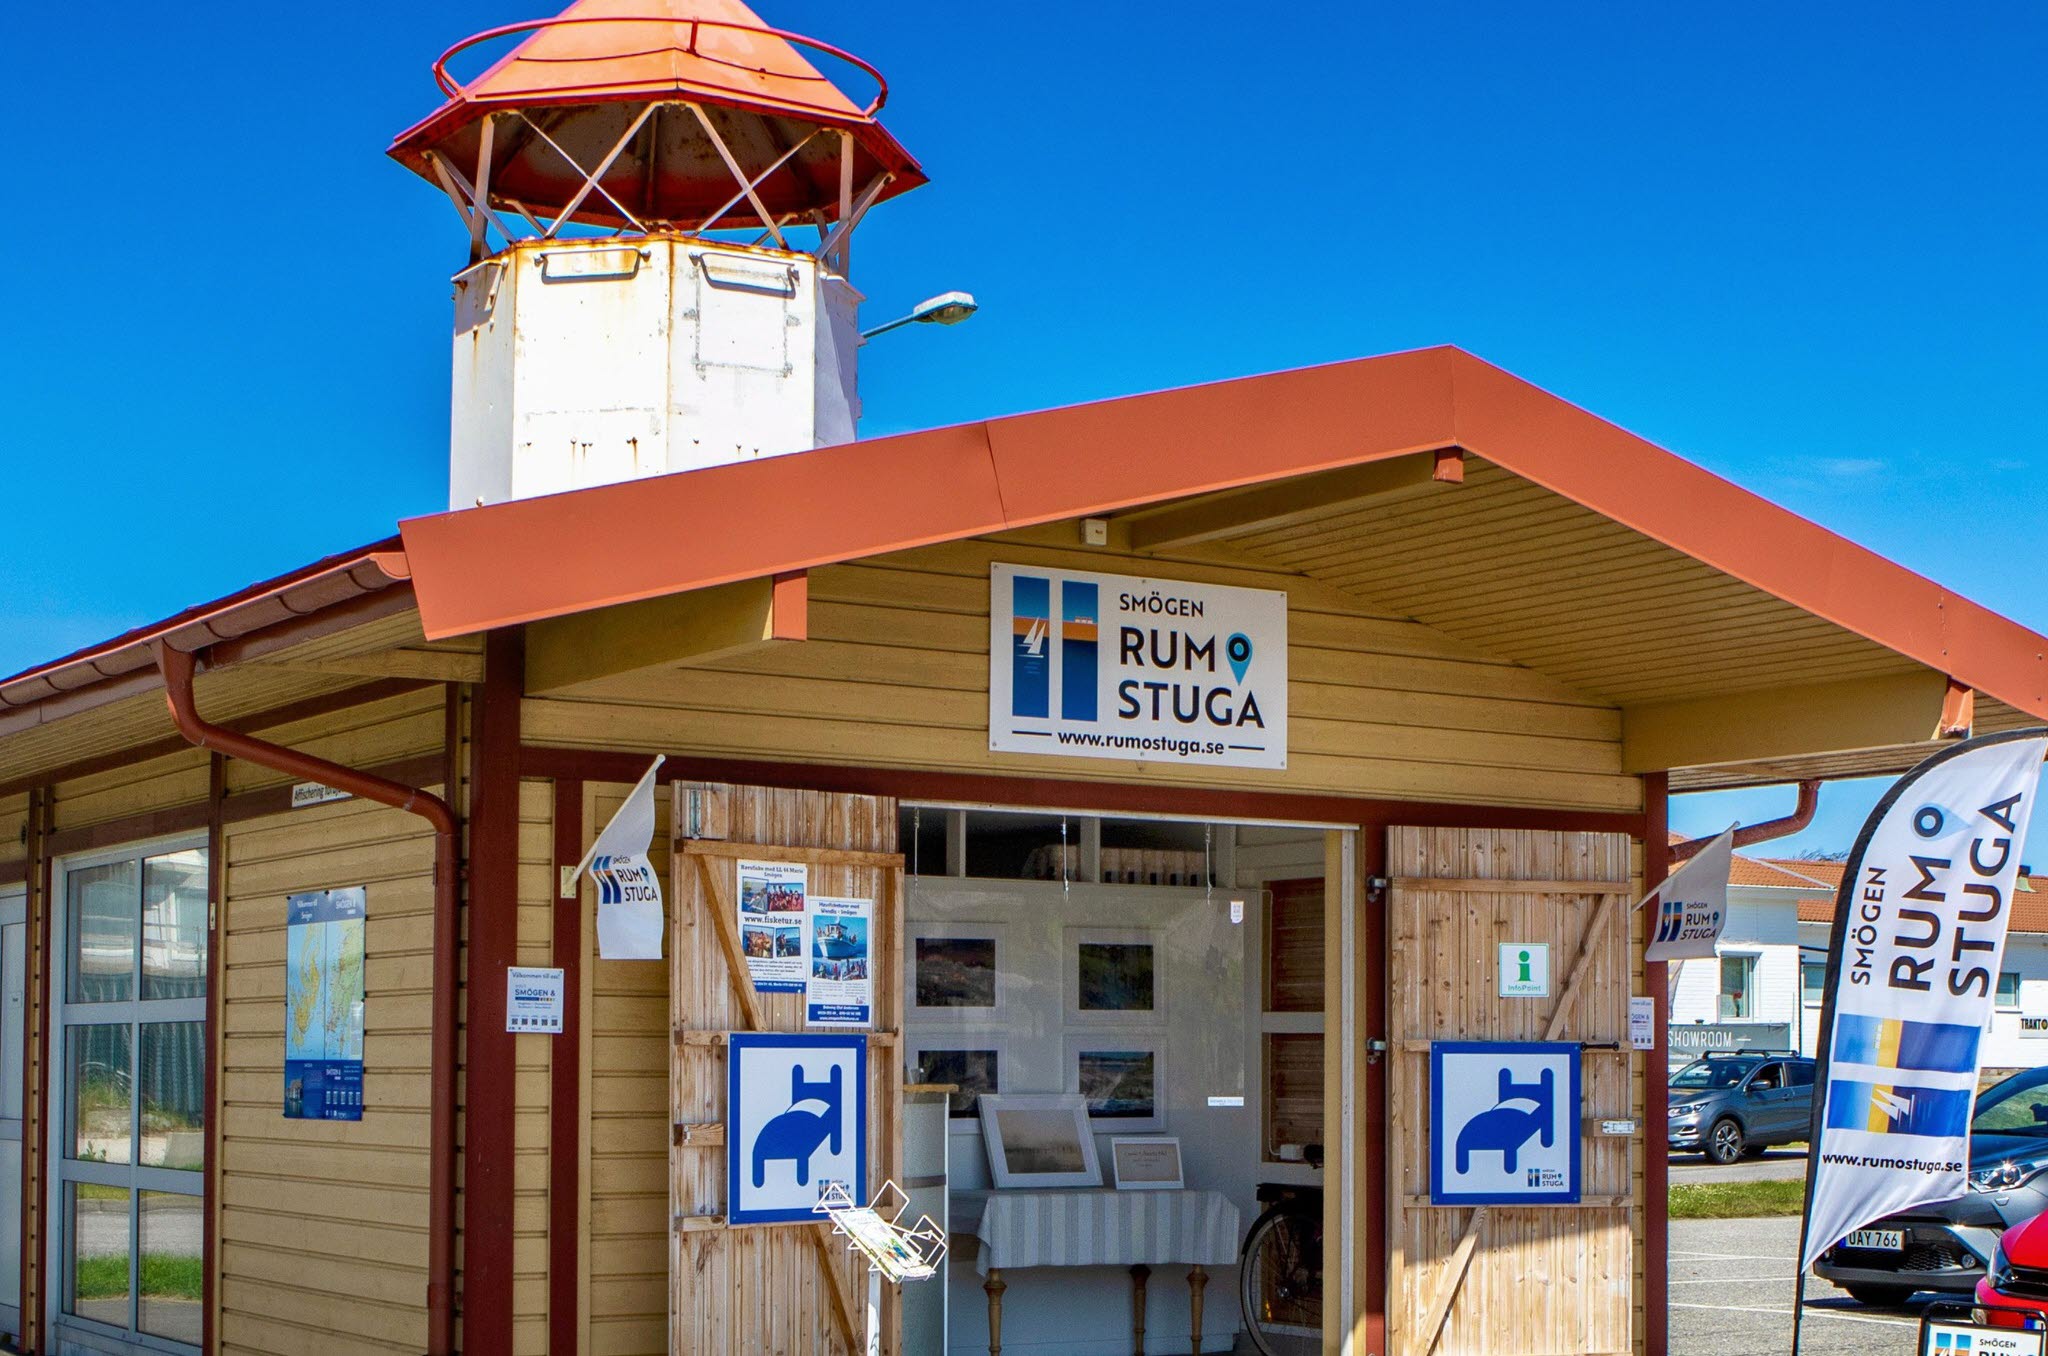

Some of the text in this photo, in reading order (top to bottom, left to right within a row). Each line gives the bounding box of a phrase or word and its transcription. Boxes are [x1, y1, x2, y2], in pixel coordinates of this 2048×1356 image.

[1119, 591, 1204, 617] SMÖGEN
[1119, 626, 1253, 673] RUMO
[1118, 679, 1265, 729] STUGA
[1057, 731, 1225, 757] www.rumostuga.se
[616, 867, 649, 883] RUMO
[624, 886, 659, 902] STUGA
[1888, 806, 1952, 992] RUMO
[1948, 791, 2023, 998] STUGA
[744, 914, 803, 925] www.fisketur.se
[1685, 911, 1720, 926] RUMO
[1850, 866, 1888, 986] SMÖGEN
[1680, 928, 1717, 941] STUGA
[515, 988, 549, 997] SMÖGEN
[1667, 1031, 1732, 1047] SHOWROOM
[1822, 1153, 1963, 1174] www.rumostuga.se
[1849, 1230, 1898, 1247] UAY 766
[1979, 1338, 2016, 1348] SMÖGEN
